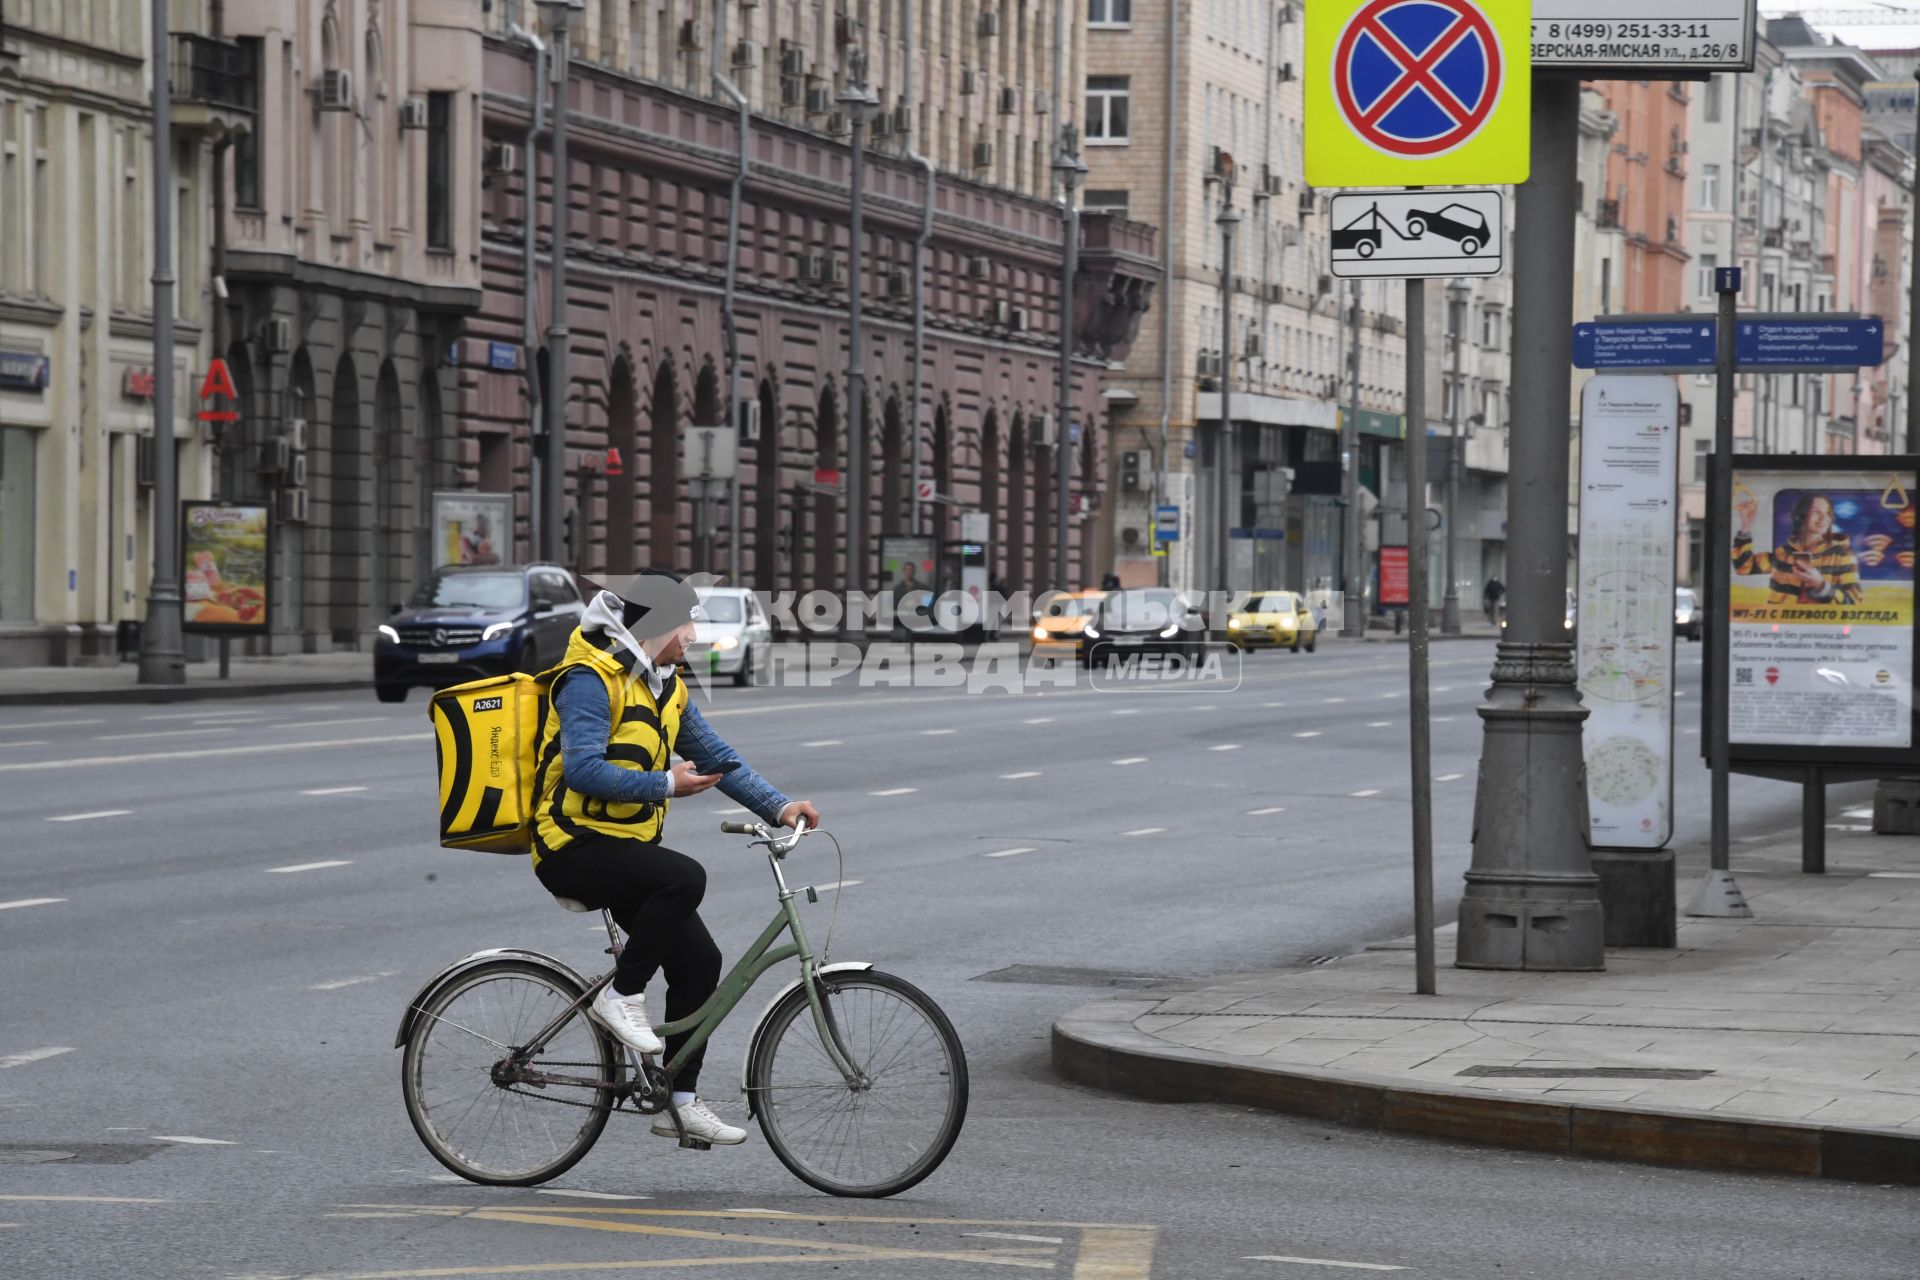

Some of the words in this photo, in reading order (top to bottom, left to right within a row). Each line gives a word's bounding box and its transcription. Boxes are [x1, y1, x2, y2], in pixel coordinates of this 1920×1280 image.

[1549, 24, 1560, 38] 8
[1565, 24, 1613, 41] (499)
[1617, 24, 1710, 38] 251-33-11
[1664, 48, 1686, 59] ул.,
[1689, 43, 1738, 60] д.26/8
[1733, 609, 1766, 619] WI-FI
[1770, 609, 1778, 619] С
[1781, 609, 1837, 620] ПЕРВОГО
[1841, 610, 1898, 621] ВЗГЛЯДА
[475, 699, 501, 711] A2621
[490, 726, 502, 759] Яндекс
[490, 760, 502, 778] Еда
